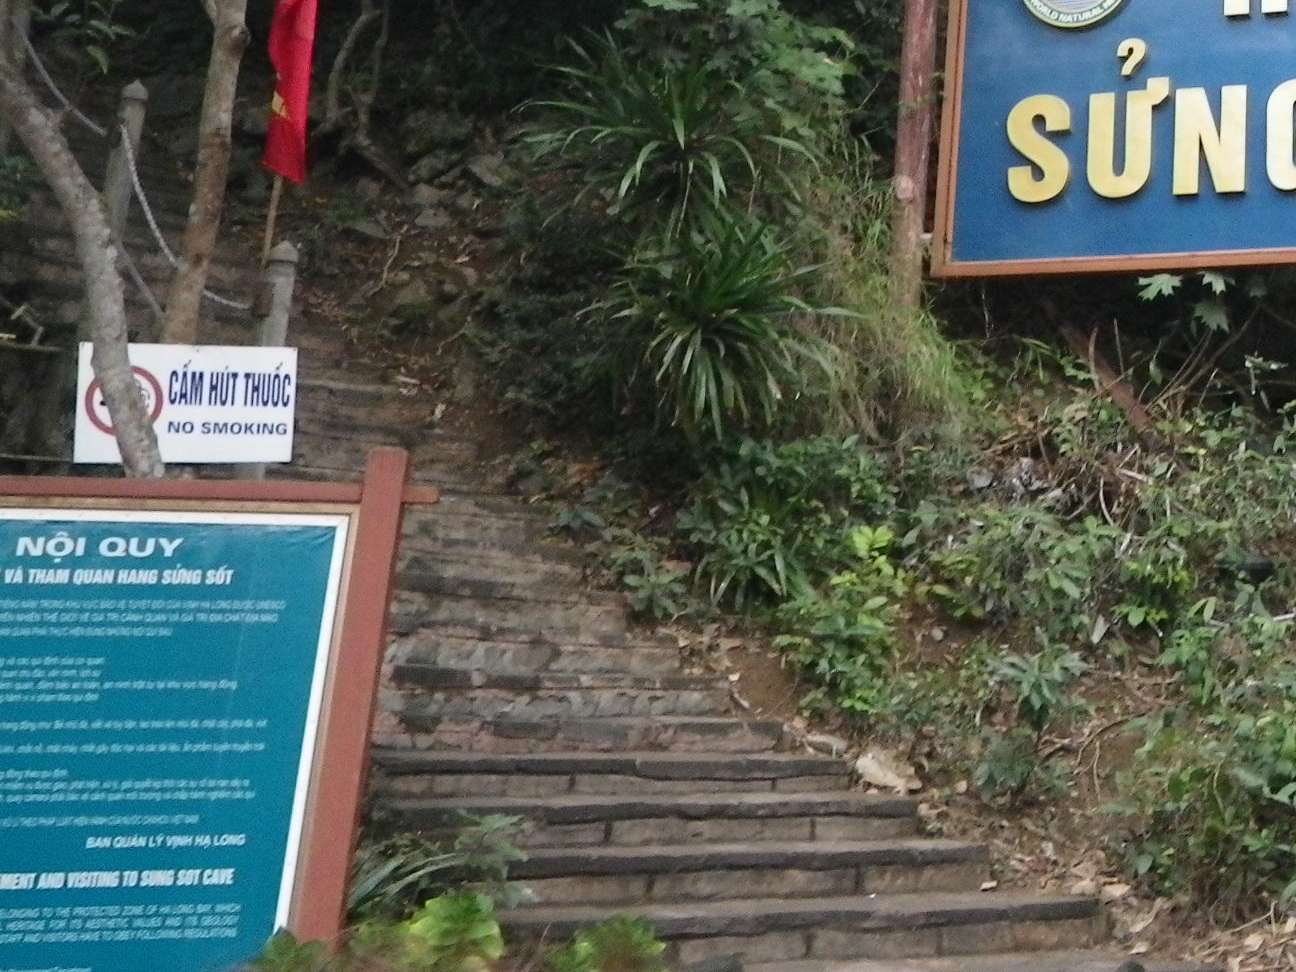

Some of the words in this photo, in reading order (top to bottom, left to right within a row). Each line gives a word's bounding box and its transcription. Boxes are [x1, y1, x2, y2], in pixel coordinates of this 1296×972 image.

[1058, 6, 1105, 23] NATURAL
[168, 359, 203, 406] CẤM
[208, 366, 239, 407] HÚT
[243, 362, 292, 408] THUỐC
[167, 421, 194, 434] NO
[201, 421, 288, 436] SMOKING
[16, 531, 87, 563] NỘI
[99, 537, 184, 558] QUY
[28, 569, 70, 584] THAM
[72, 569, 115, 585] QUAN
[117, 569, 158, 585] HANG
[86, 836, 113, 849] BAN
[213, 833, 246, 846] LONG
